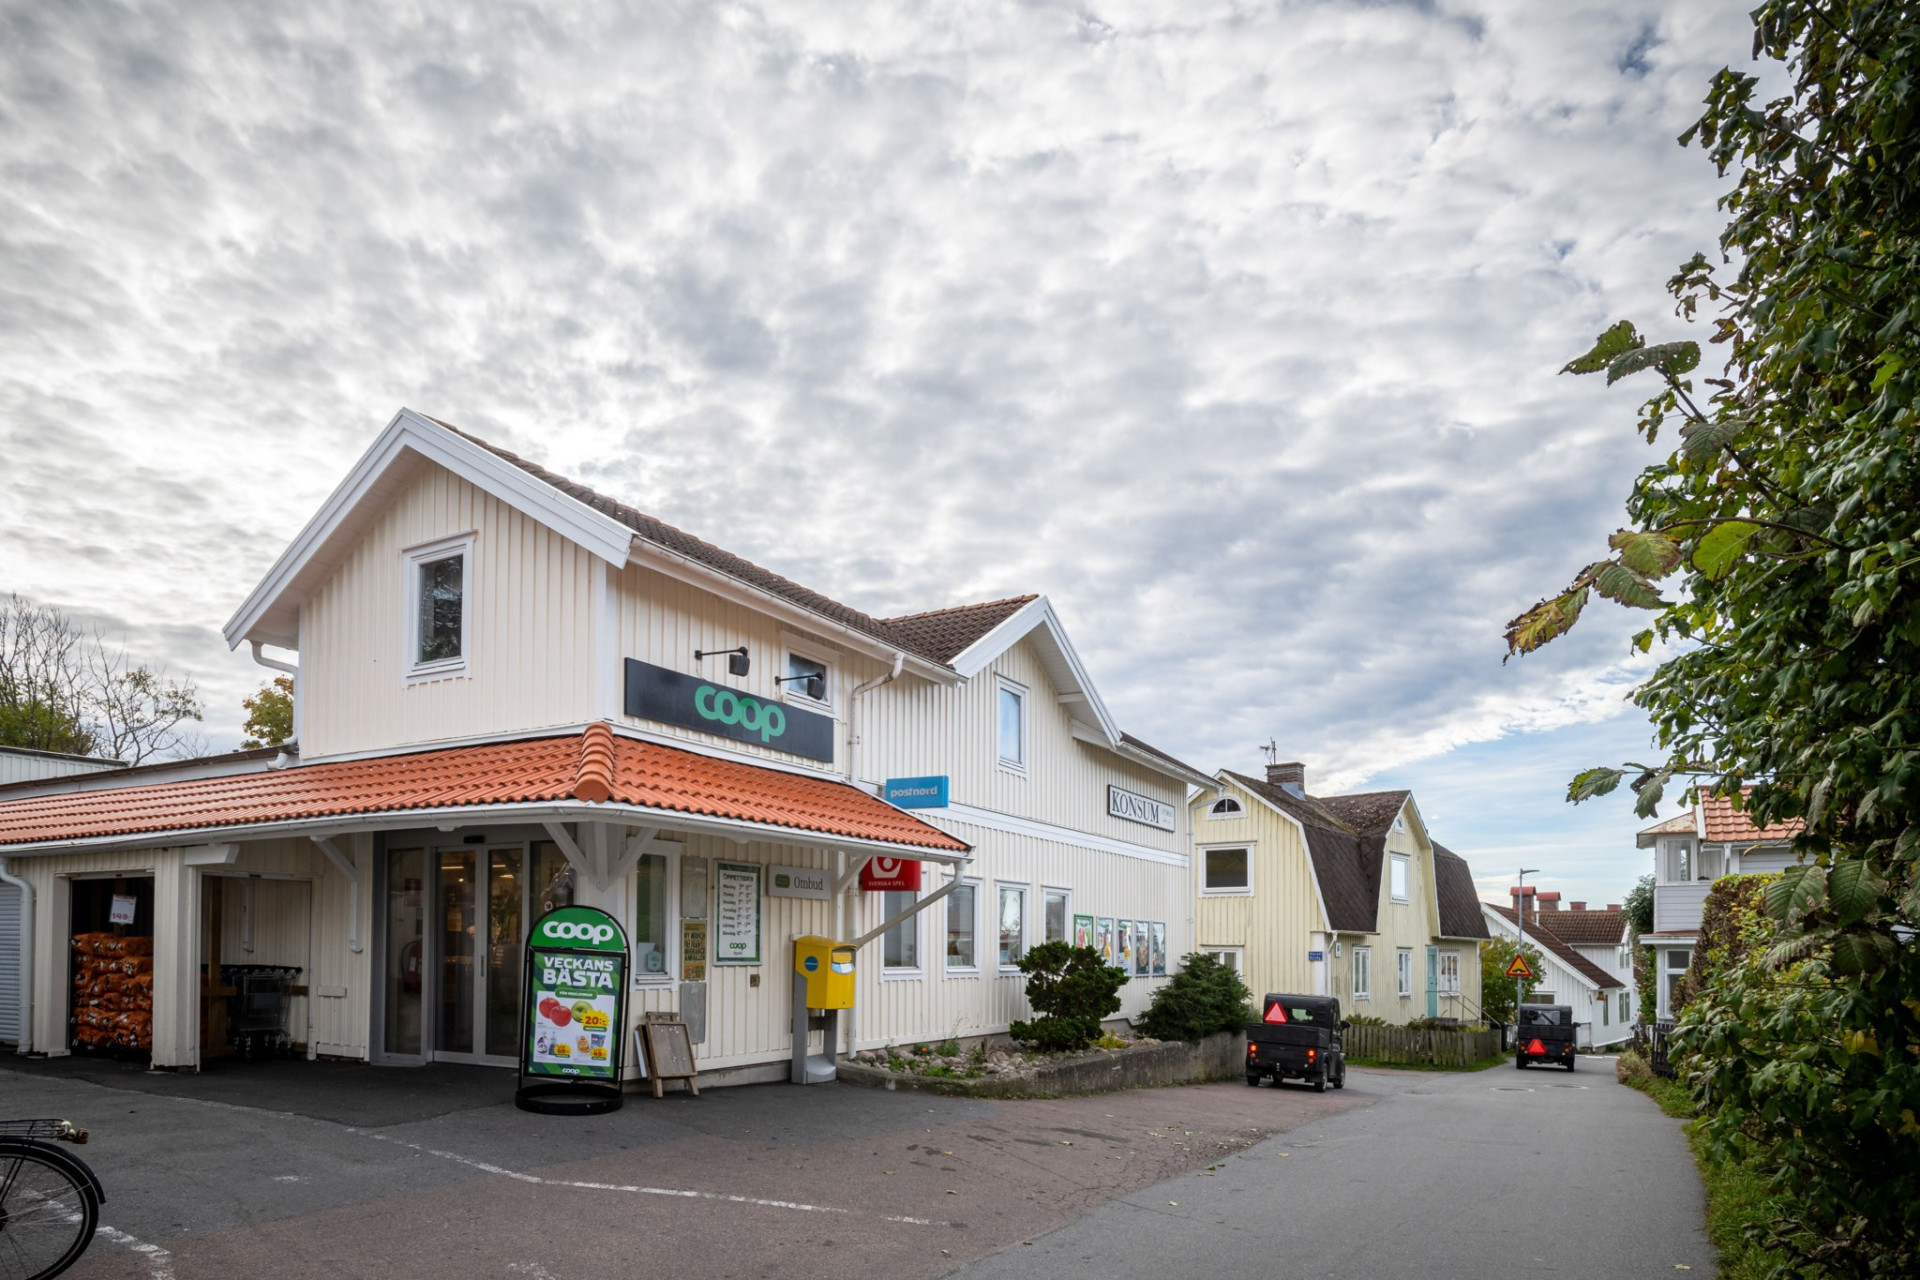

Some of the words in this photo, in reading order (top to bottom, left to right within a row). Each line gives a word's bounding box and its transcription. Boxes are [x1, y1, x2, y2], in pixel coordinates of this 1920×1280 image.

[694, 685, 786, 743] coop
[890, 786, 938, 799] postnord
[1112, 790, 1159, 824] KONSUM
[794, 877, 823, 890] Ombud
[543, 921, 614, 945] coop
[729, 942, 747, 951] coop
[544, 956, 614, 972] VECKANS
[543, 967, 613, 989] BÄSTA
[562, 1067, 580, 1075] coop
